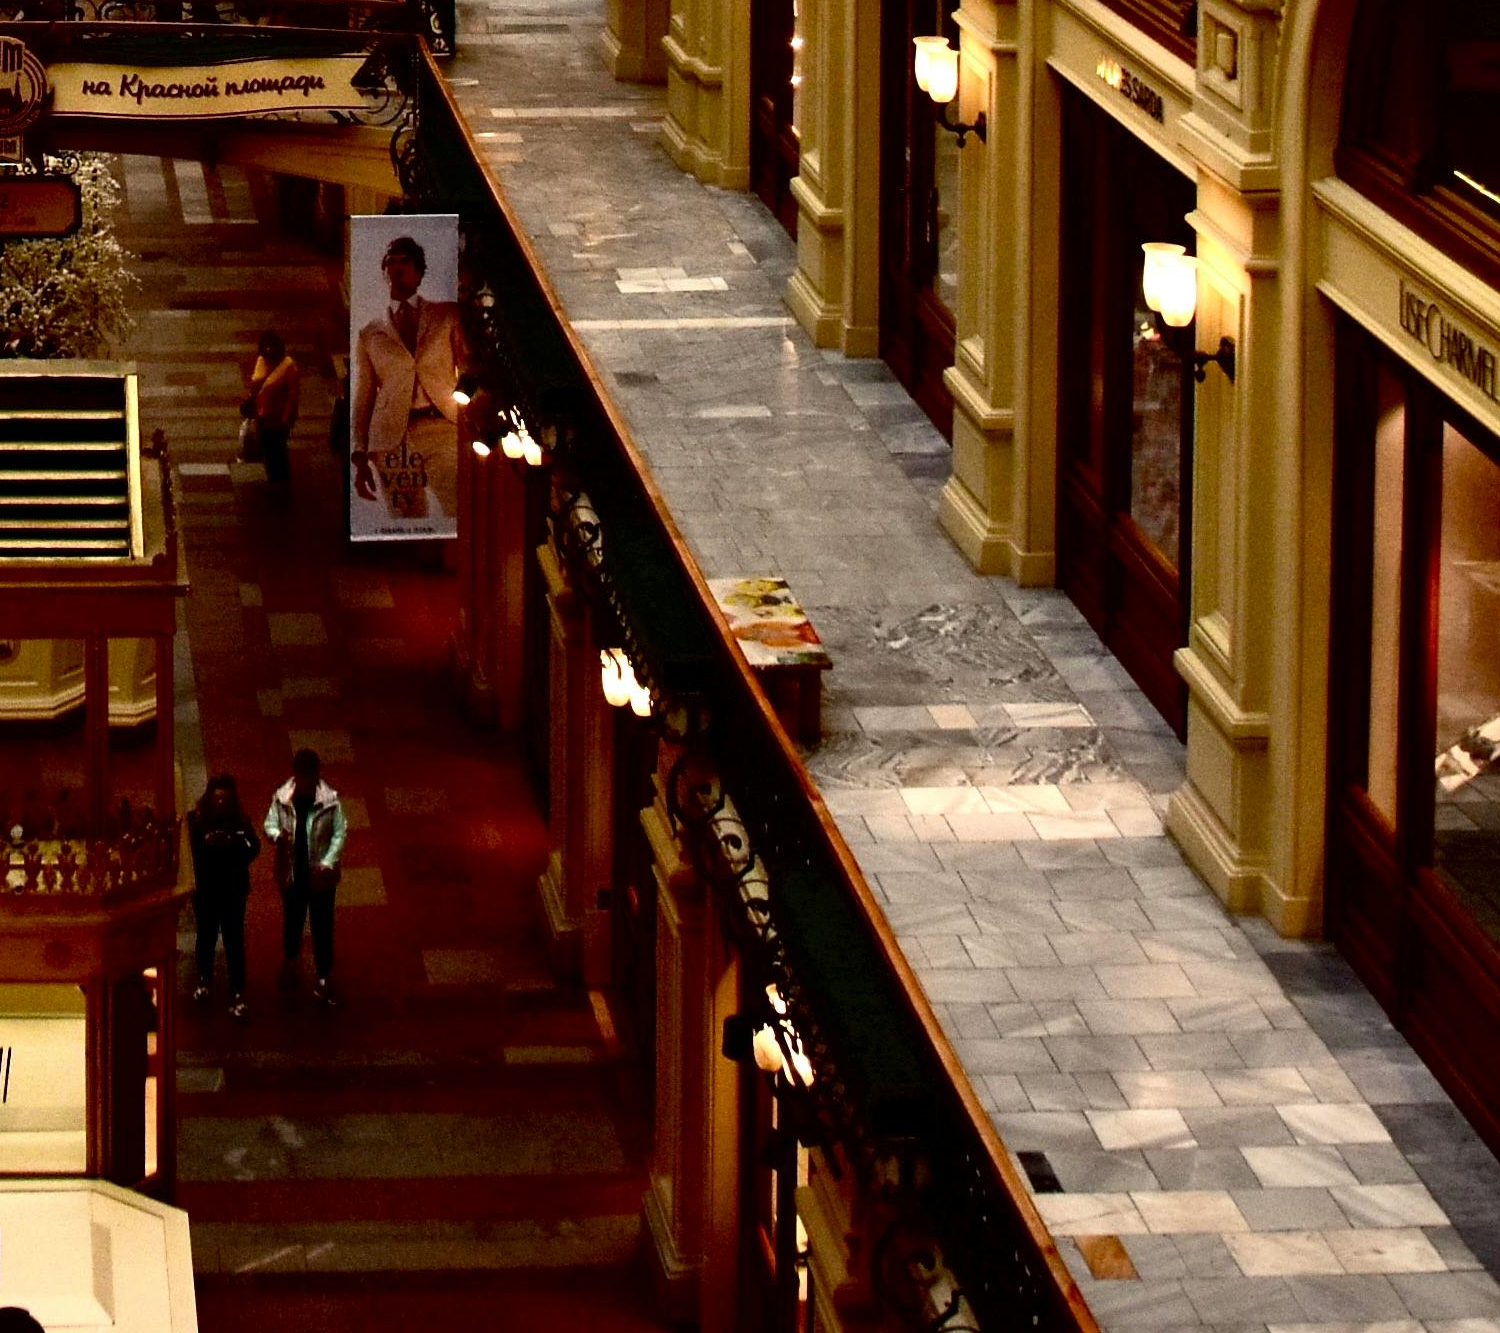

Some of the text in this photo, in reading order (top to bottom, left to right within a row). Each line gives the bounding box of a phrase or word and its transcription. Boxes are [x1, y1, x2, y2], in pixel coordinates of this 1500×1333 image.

[81, 73, 325, 105] на Красной площади
